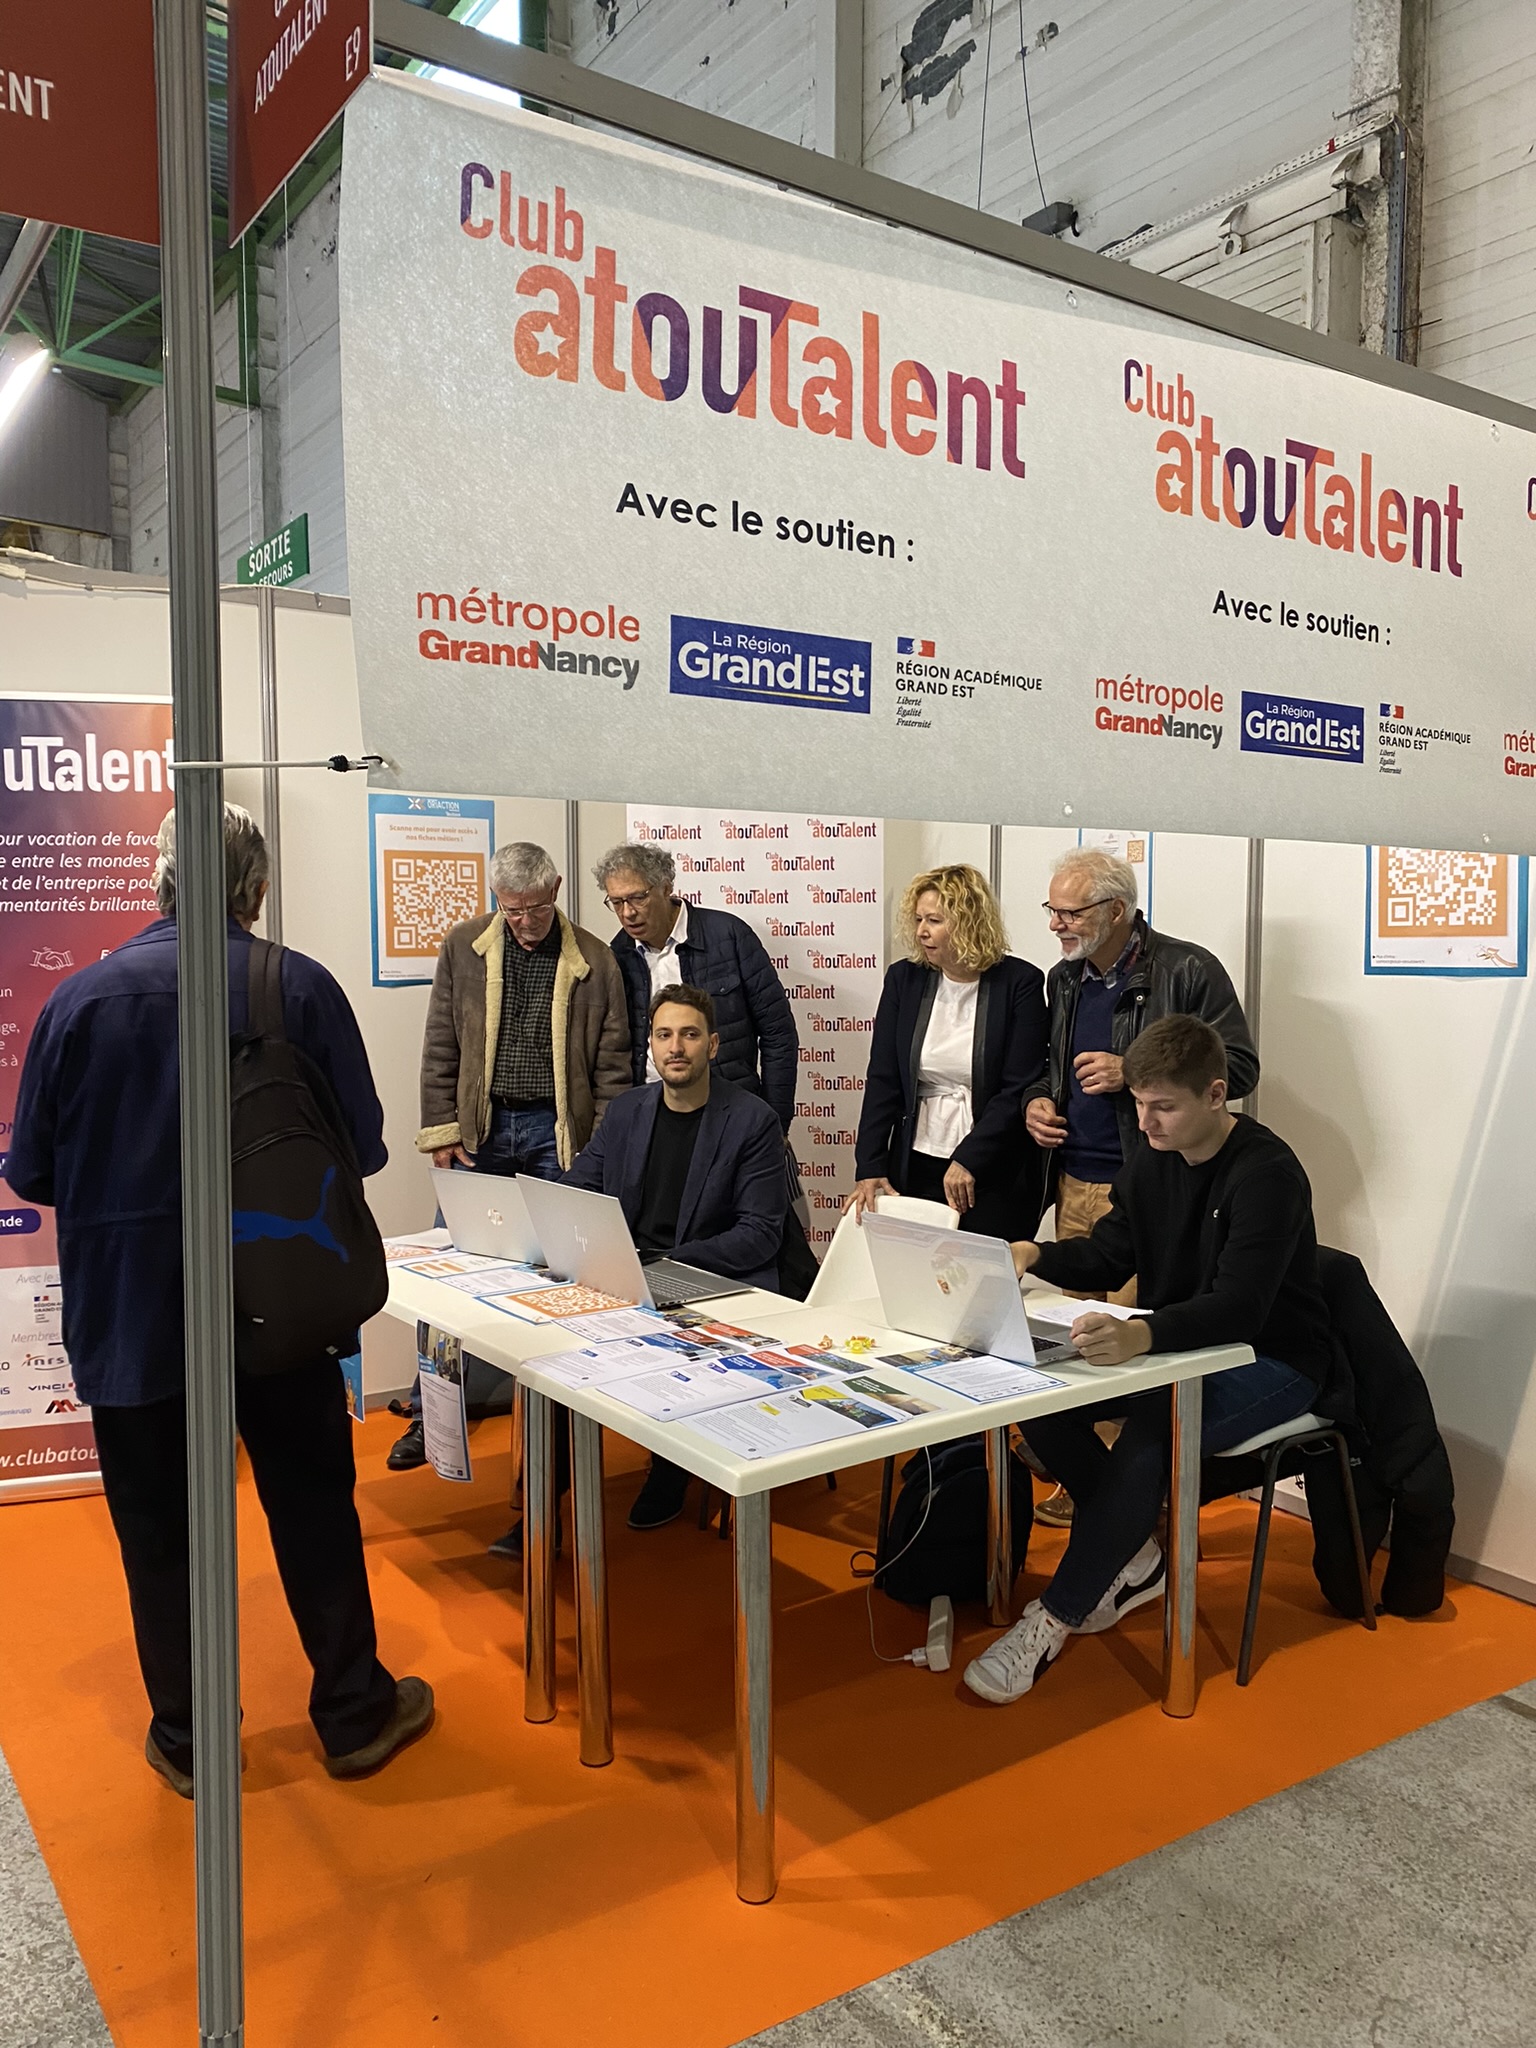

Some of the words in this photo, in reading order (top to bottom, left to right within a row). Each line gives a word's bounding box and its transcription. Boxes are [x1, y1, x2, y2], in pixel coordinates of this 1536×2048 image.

[345, 26, 361, 81] E9
[460, 162, 584, 262] Club
[513, 246, 1026, 479] atouTalent
[1124, 359, 1195, 428] Club
[1155, 415, 1464, 578] atouTalent
[616, 482, 717, 529] Avec
[731, 501, 763, 536] le
[775, 514, 895, 559] soutien
[248, 529, 291, 578] SORTIE
[416, 587, 640, 642] métropole
[1212, 590, 1272, 624] Avec
[1280, 602, 1299, 628] le
[1306, 611, 1379, 643] soutien
[712, 630, 732, 648] La
[737, 634, 791, 655] Région
[418, 629, 640, 691] GrandNancy
[896, 659, 950, 680] RÉGION
[954, 669, 1043, 691] ACADÉMIQUE
[895, 678, 948, 695] GRAND
[952, 685, 975, 698] EST
[1095, 674, 1223, 714] métropole
[896, 696, 922, 706] Liberté
[1266, 702, 1279, 715] La
[1281, 704, 1315, 720] Région
[1095, 706, 1223, 749] GrandNancy
[1379, 721, 1413, 736] RÉGION
[1415, 728, 1471, 744] ACADÉMIQUE
[1378, 735, 1411, 748] GRAND
[1413, 740, 1429, 751] EST
[639, 824, 702, 840] atouTalent
[725, 823, 789, 839] atouTalent
[813, 822, 877, 838] atouTalent
[28, 832, 97, 846] vocation
[102, 832, 121, 846] de
[12, 855, 54, 868] entre
[60, 853, 82, 868] les
[87, 853, 150, 868] mondes
[682, 856, 745, 872] atouTalent
[771, 855, 835, 871] atouTalent
[12, 875, 32, 890] de
[725, 889, 789, 904] atouTalent
[813, 887, 877, 904] atouTalent
[771, 920, 835, 936] atouTalent
[812, 953, 877, 969] atouTalent
[813, 1075, 867, 1091] atouTale
[803, 1226, 835, 1242] alent
[16, 1274, 41, 1284] Avec
[28, 1383, 66, 1391] VINCI
